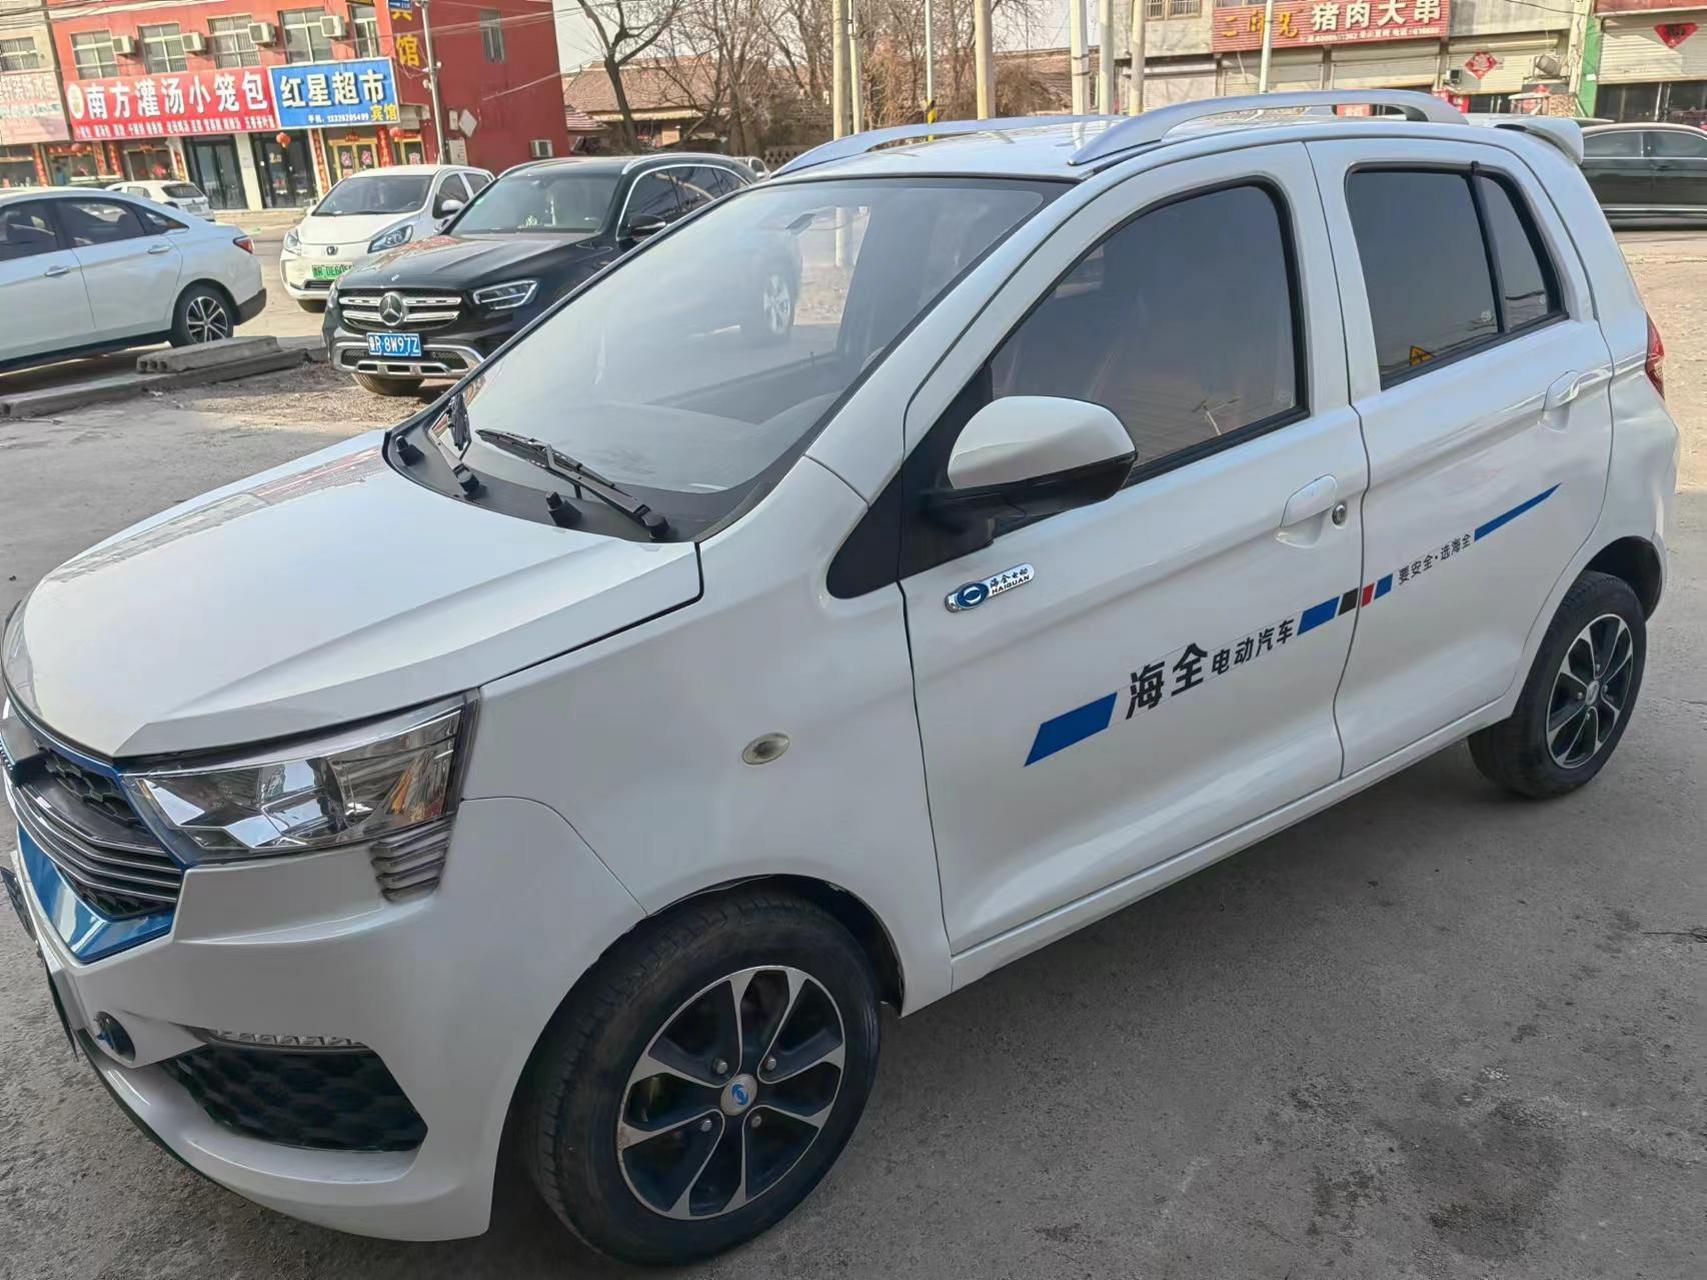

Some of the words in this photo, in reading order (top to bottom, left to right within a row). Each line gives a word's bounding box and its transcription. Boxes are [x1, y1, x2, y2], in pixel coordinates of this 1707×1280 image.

[1311, 0, 1440, 31] 猪肉大串
[84, 71, 268, 120] 南方灌汤小笼包
[280, 69, 387, 108] 红星超市
[371, 103, 398, 121] 宾馆
[1398, 533, 1471, 585] 要安全·选海全
[991, 575, 1030, 595] HAIQUAN
[1125, 618, 1294, 720] 海全电动汽车
